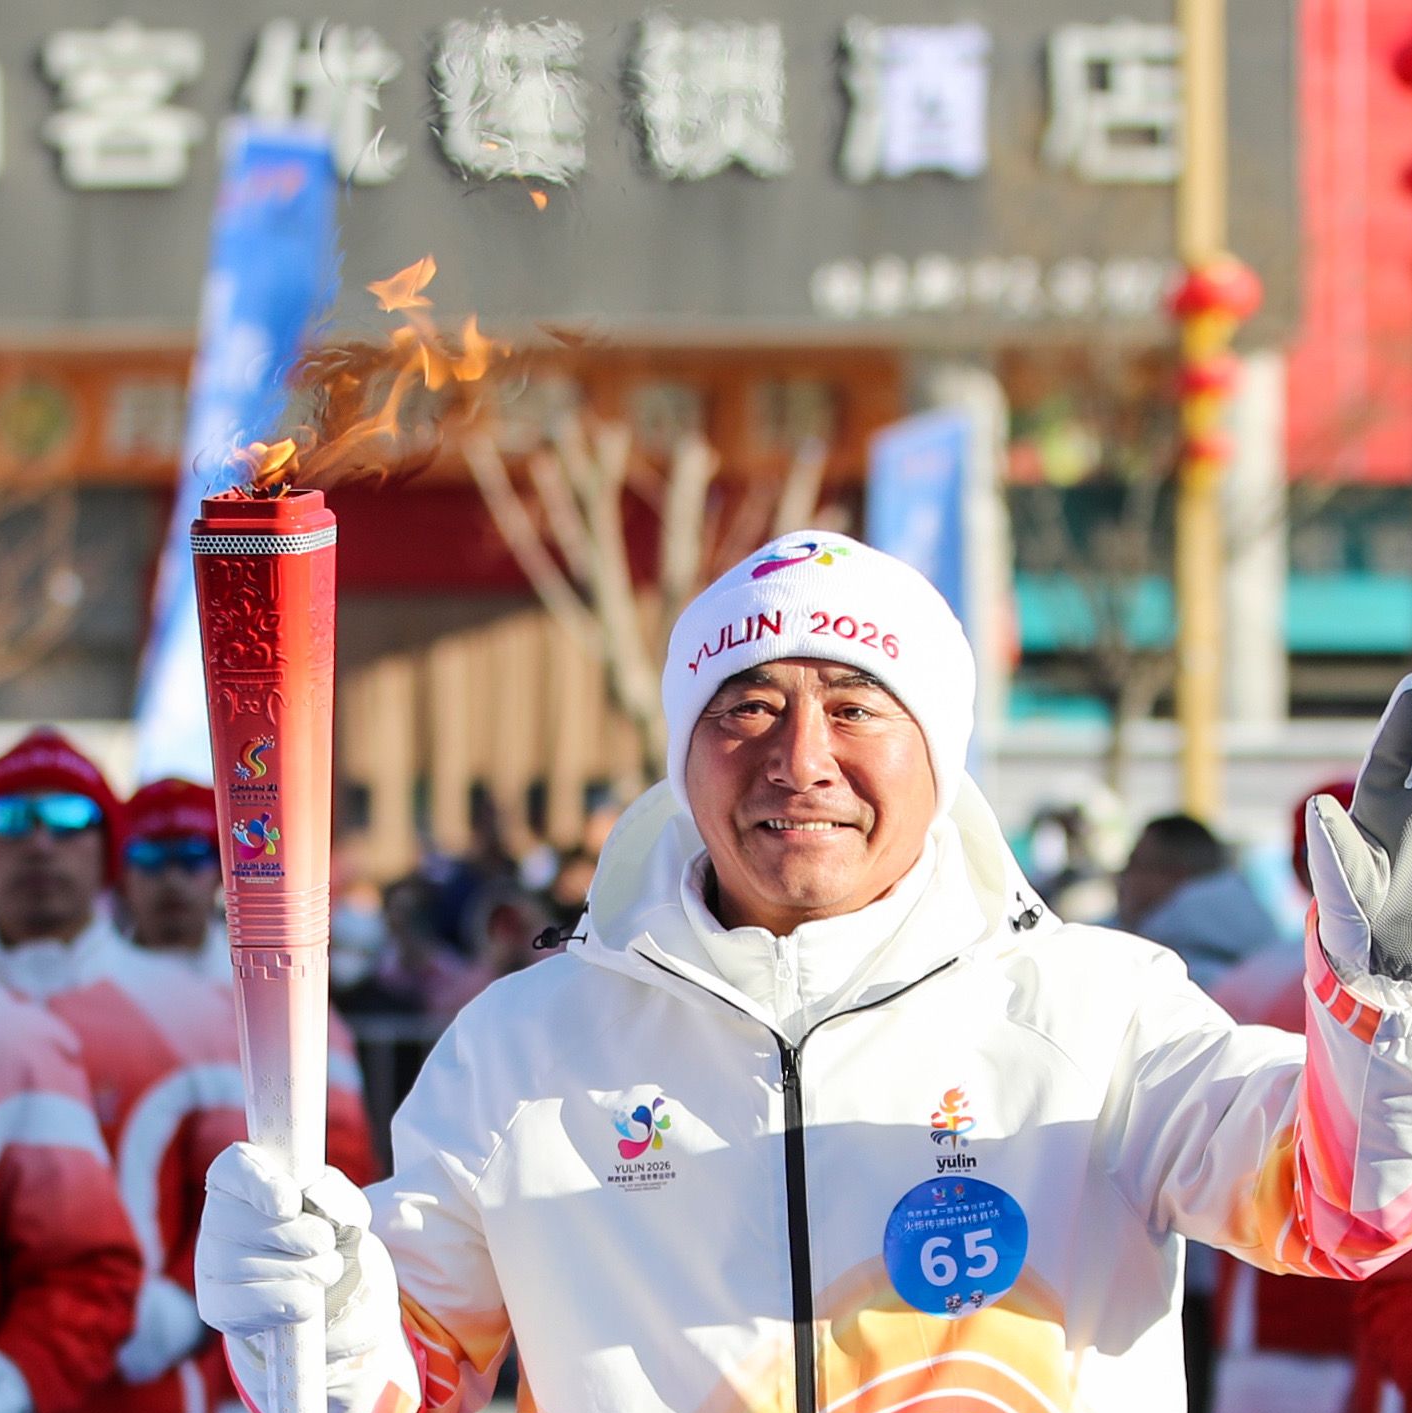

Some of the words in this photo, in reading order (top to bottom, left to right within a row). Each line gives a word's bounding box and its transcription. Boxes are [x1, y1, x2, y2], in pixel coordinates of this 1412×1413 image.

[688, 609, 783, 675] YULIN
[809, 610, 900, 660] 2026
[615, 1163, 645, 1174] YULIN
[646, 1161, 671, 1172] 2026
[936, 1153, 977, 1174] yulin
[919, 1228, 999, 1288] 65
